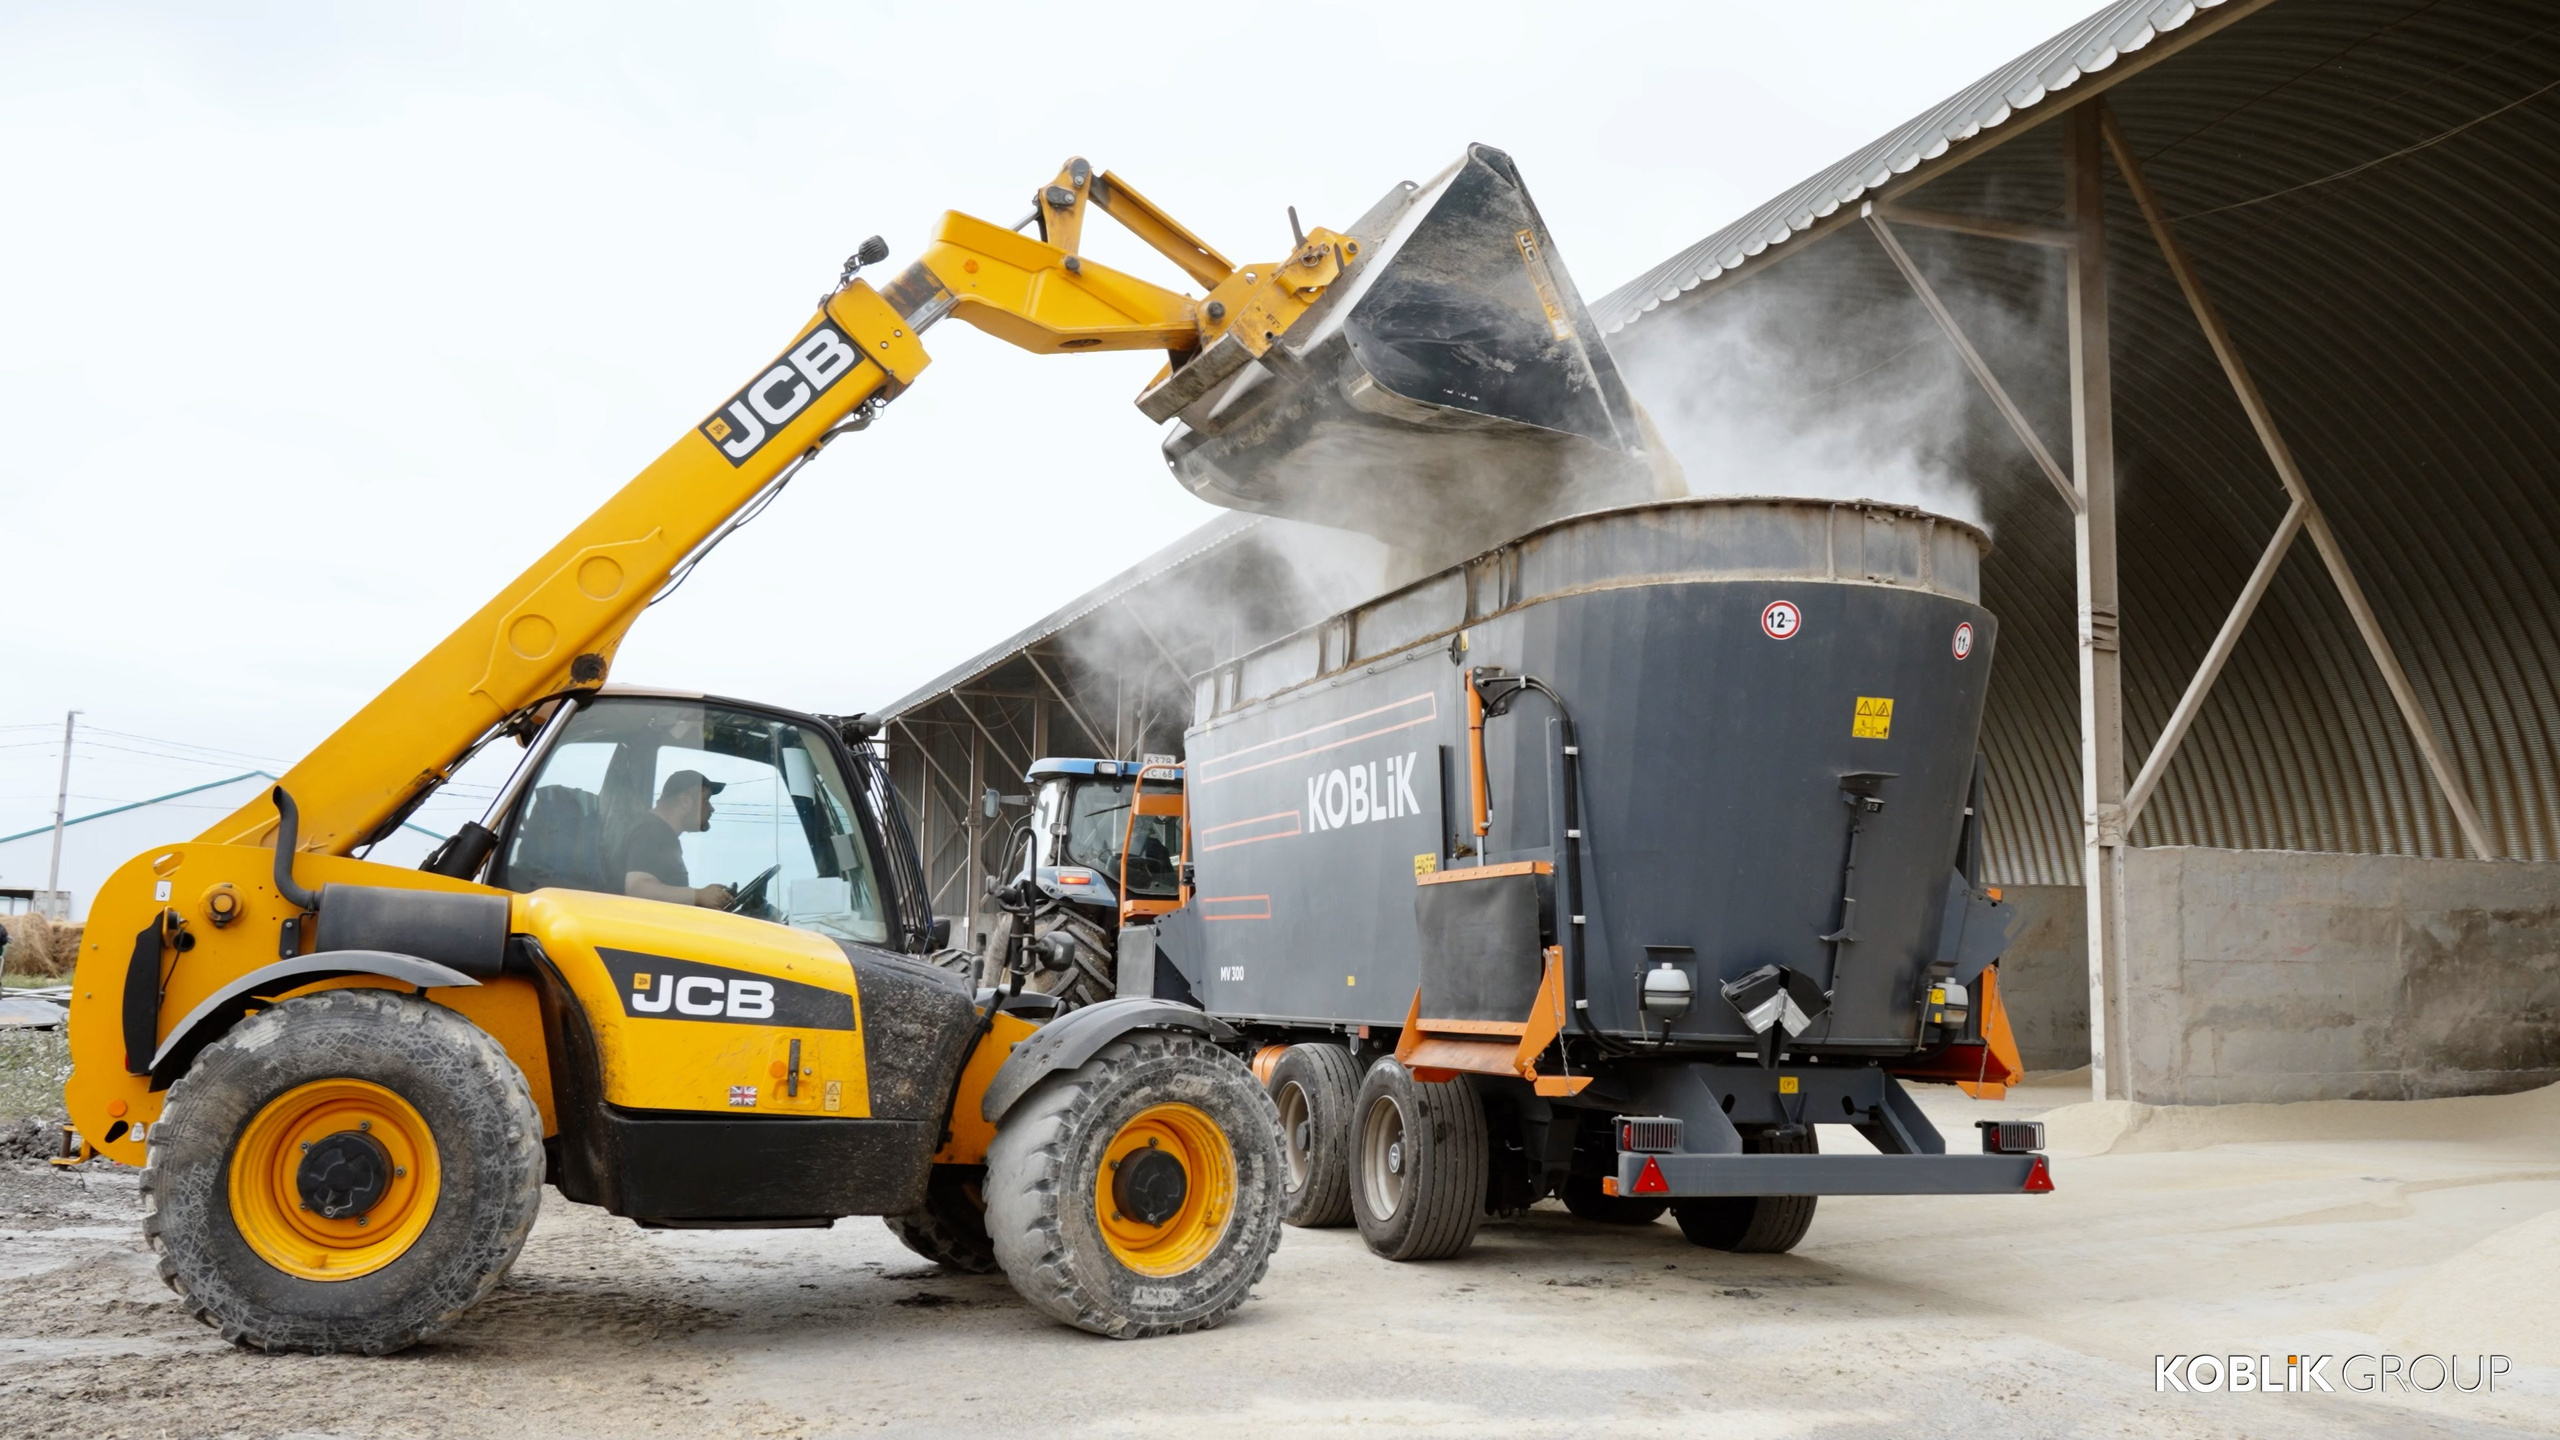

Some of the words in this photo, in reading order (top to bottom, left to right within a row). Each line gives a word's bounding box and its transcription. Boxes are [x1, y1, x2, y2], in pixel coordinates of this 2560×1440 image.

[722, 328, 855, 458] JCB
[1768, 611, 1785, 628] 12
[1220, 966, 1231, 981] MV
[1231, 965, 1244, 981] 300
[631, 974, 775, 1019] JCB
